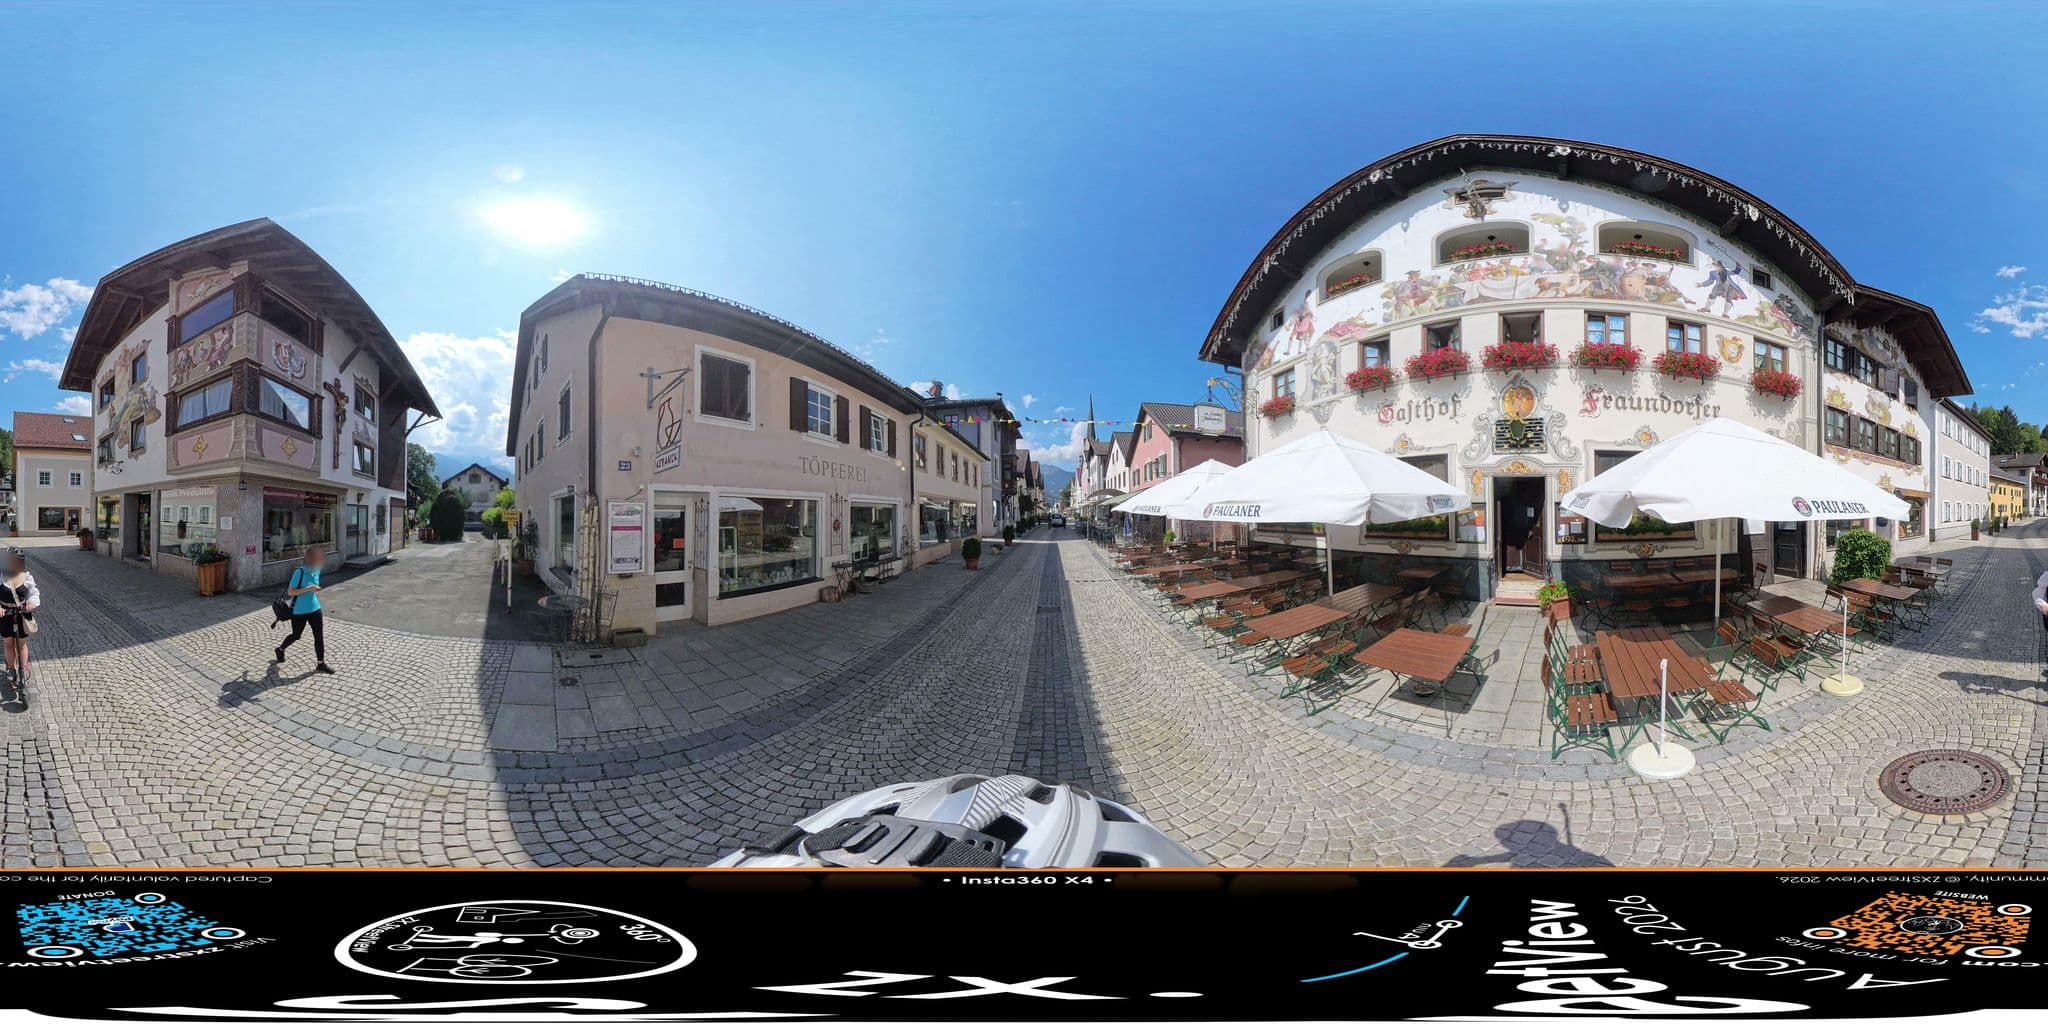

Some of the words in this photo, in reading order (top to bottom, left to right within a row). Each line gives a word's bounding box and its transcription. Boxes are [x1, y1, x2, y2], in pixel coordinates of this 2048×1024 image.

[1579, 388, 1720, 419] Fraundorfer
[799, 456, 866, 482] TÖPFEREI
[1213, 505, 1261, 517] PAULANER
[1811, 500, 1870, 514] PAULANER
